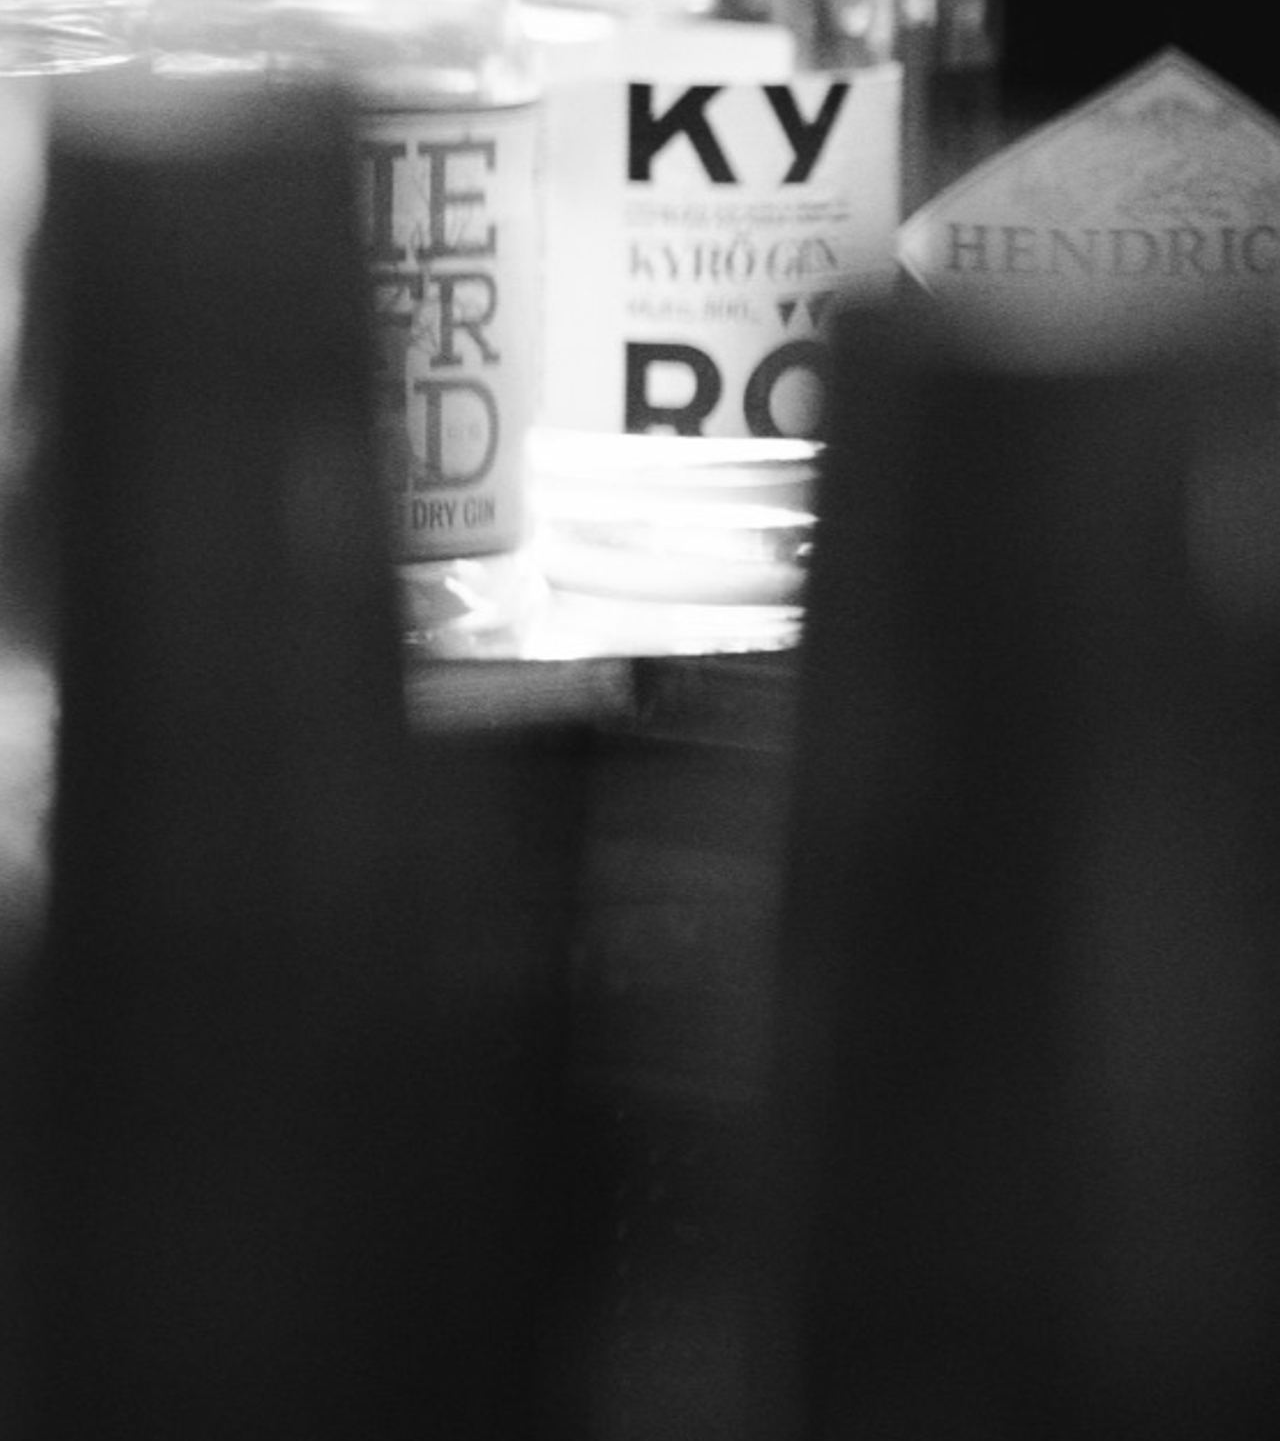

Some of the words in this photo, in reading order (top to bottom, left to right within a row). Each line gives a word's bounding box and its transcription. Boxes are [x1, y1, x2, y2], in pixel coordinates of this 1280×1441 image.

[626, 82, 850, 185] KY
[410, 497, 457, 532] DRY
[463, 496, 497, 530] GIN
